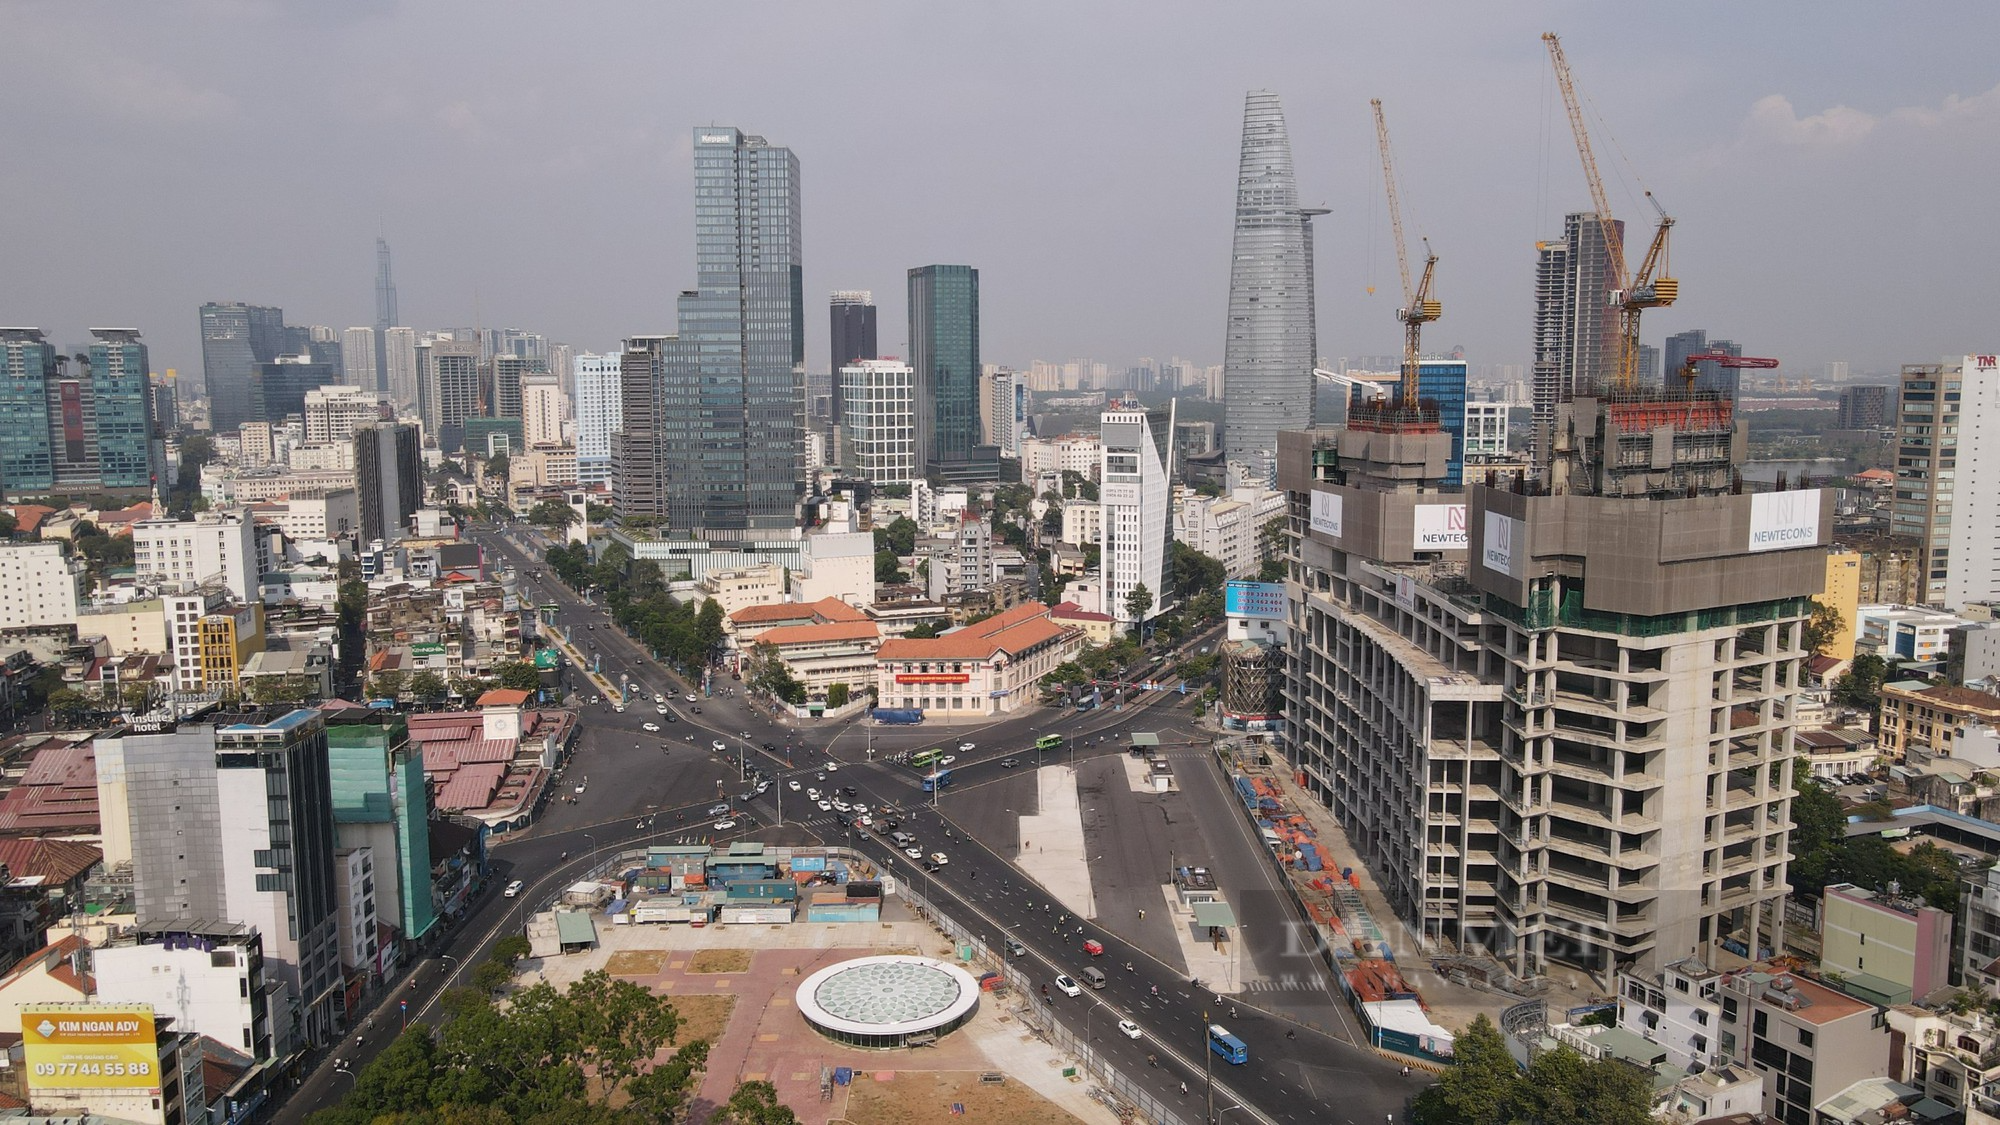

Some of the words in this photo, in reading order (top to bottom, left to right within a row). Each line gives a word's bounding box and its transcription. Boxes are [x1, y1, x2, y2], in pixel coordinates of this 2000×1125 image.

[701, 135, 730, 143] Keppel
[1977, 356, 1997, 366] TNR
[1122, 401, 1138, 409] MB
[1312, 516, 1339, 531] NEWTECONS
[1753, 527, 1813, 543] NEWTECONS
[133, 722, 162, 732] hotel
[59, 1021, 80, 1032] KIM
[82, 1021, 114, 1032] NGAN
[116, 1021, 139, 1032] ADV
[35, 1062, 55, 1076] 09
[57, 1062, 78, 1076] 77
[80, 1062, 100, 1076] 44
[104, 1062, 125, 1076] 55
[128, 1062, 150, 1076] 88
